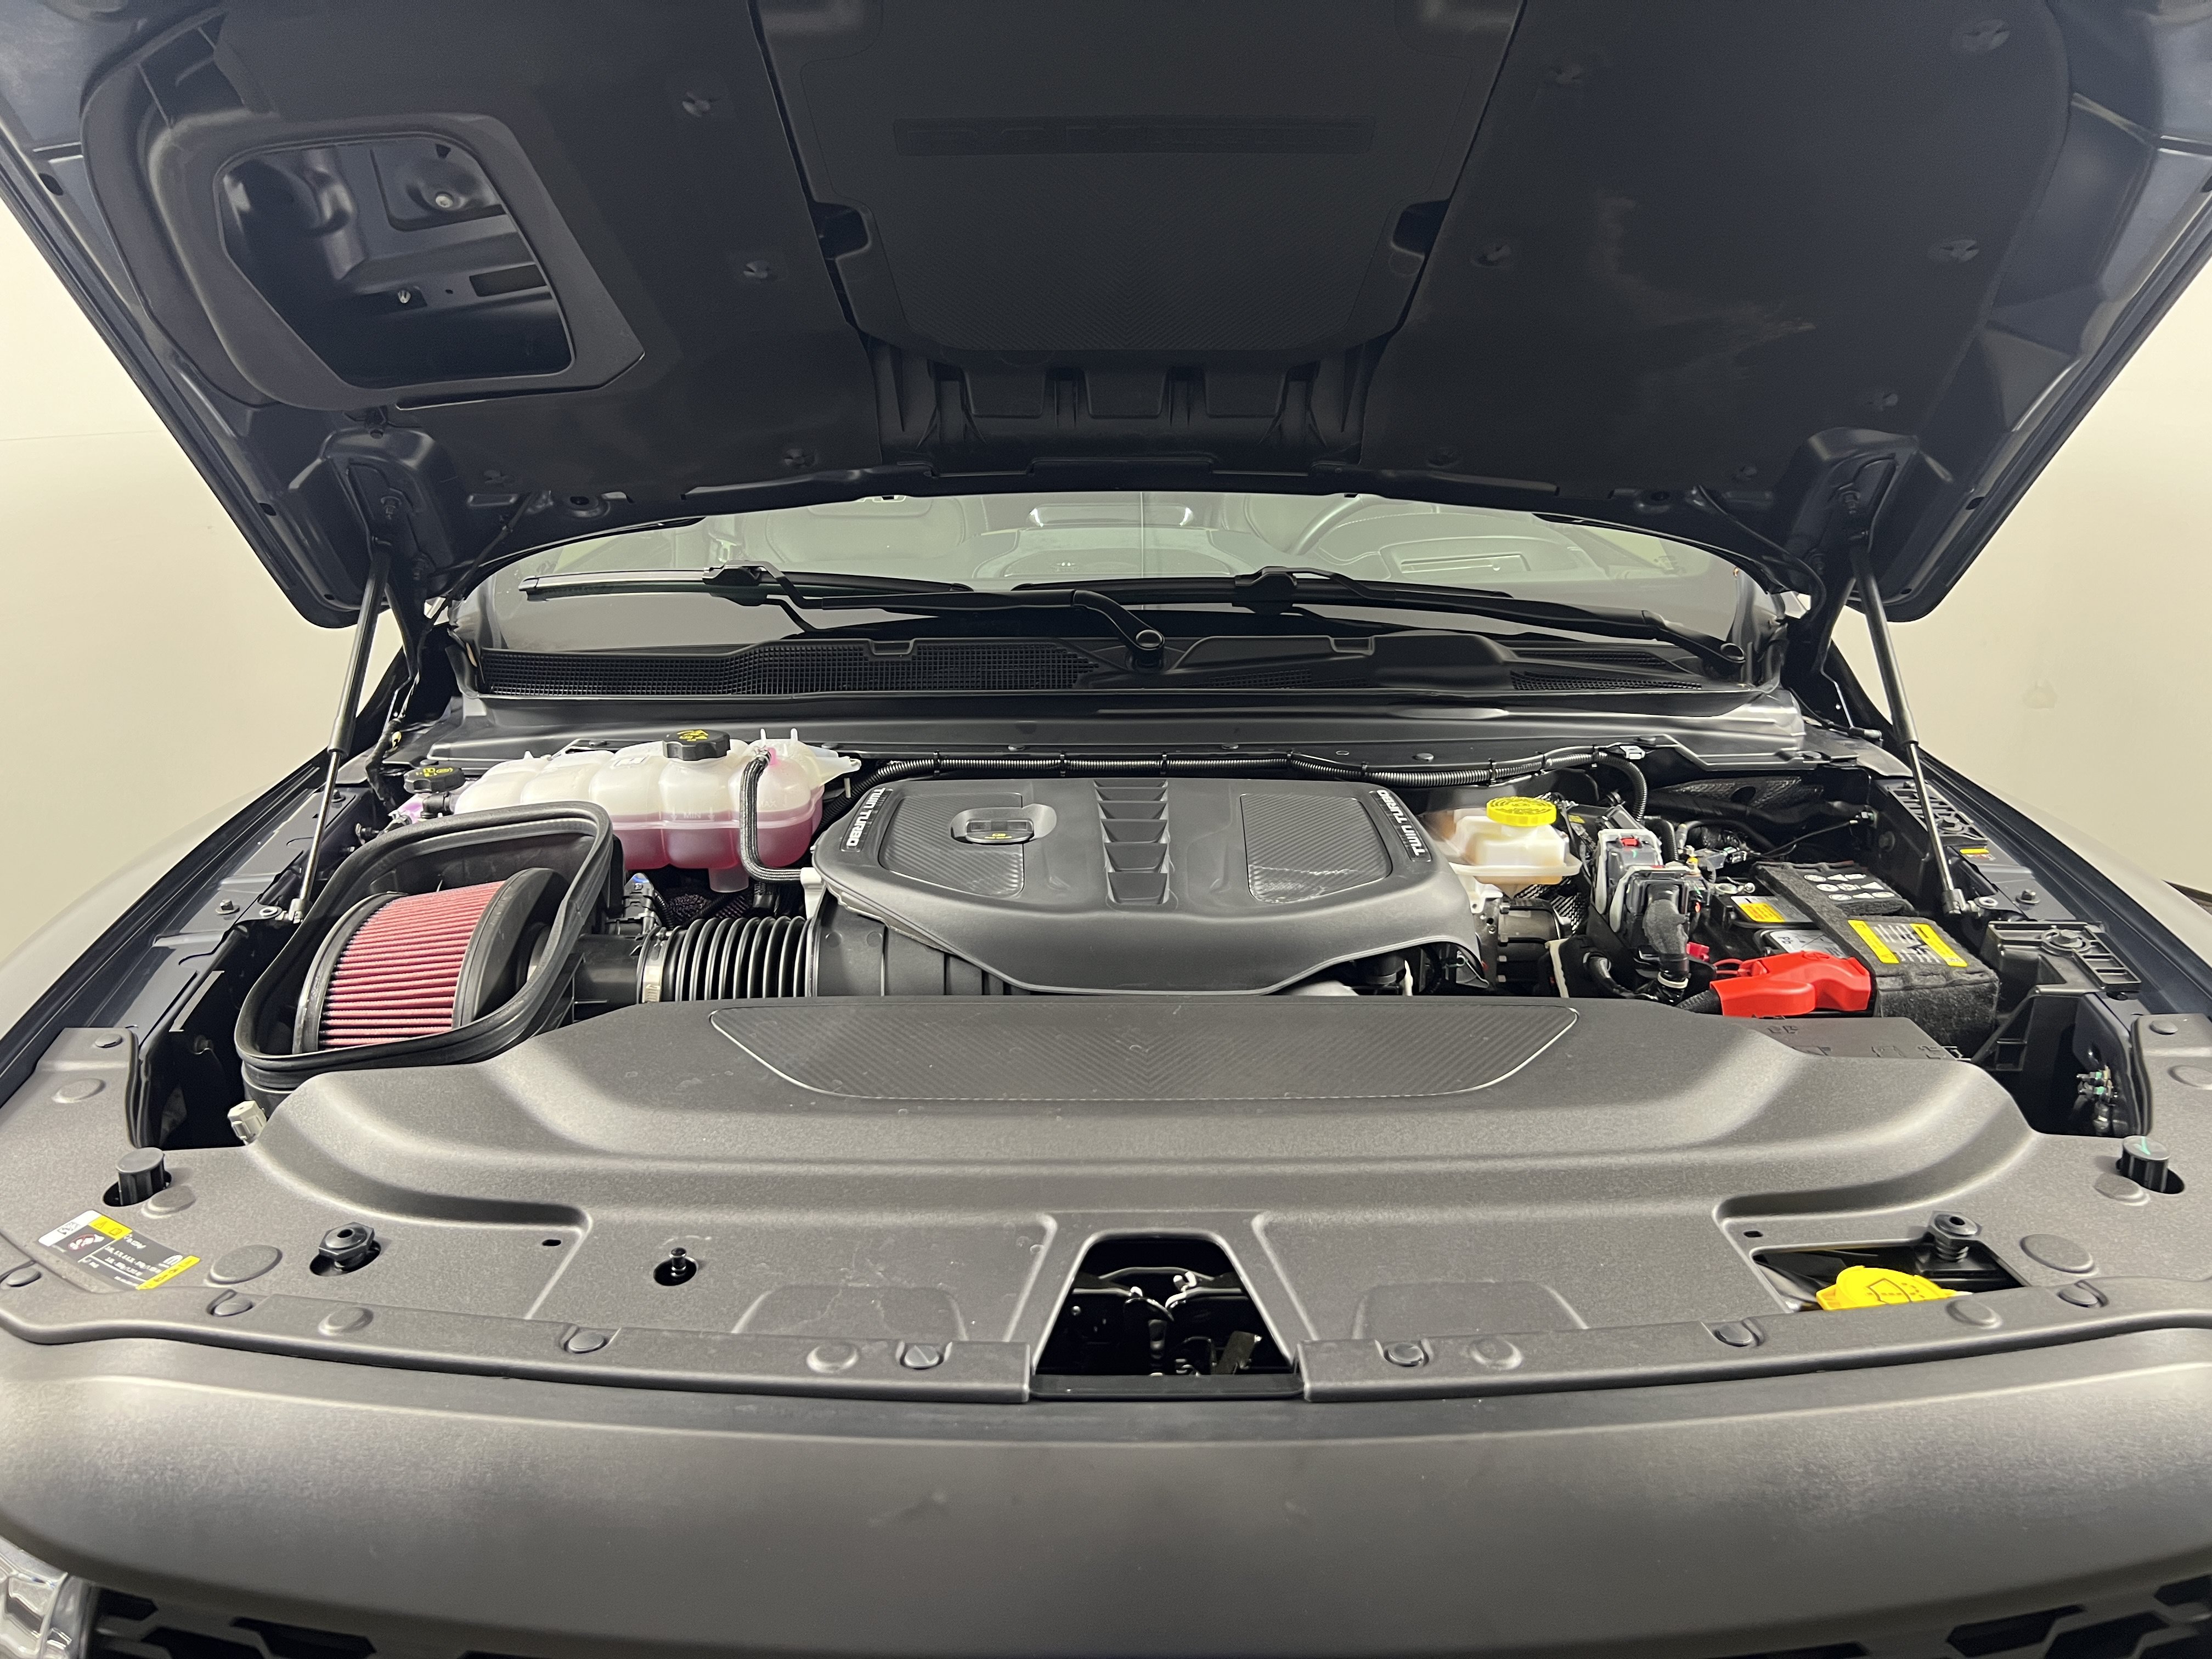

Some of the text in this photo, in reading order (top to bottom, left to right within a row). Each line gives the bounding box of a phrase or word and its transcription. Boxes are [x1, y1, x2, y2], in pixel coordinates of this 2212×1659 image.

[846, 787, 886, 847] TWIN TURBO
[1376, 789, 1425, 856] TWIN TURBO
